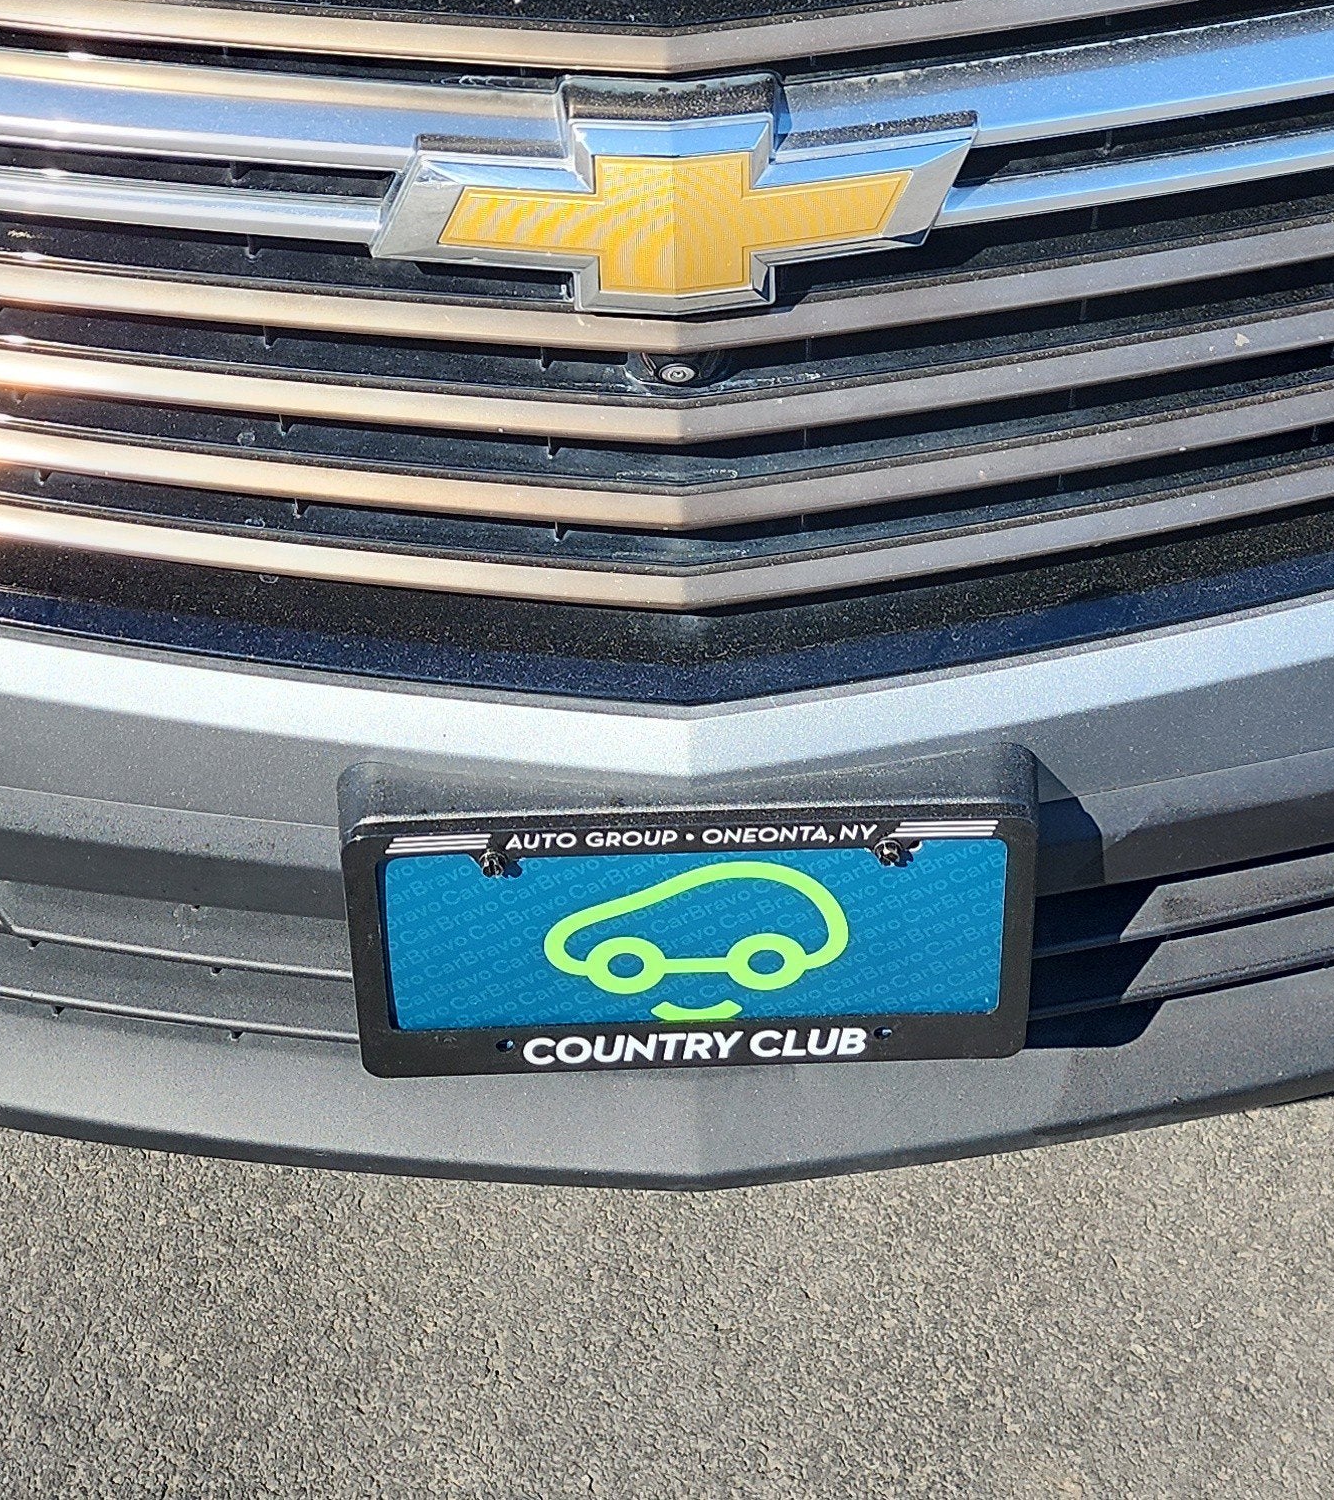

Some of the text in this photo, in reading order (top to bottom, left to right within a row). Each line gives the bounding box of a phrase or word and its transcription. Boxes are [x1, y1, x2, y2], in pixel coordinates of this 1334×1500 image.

[505, 833, 577, 851] AUTO
[584, 829, 678, 848] GROUP
[523, 1027, 868, 1065] COUNTRY CLUB
